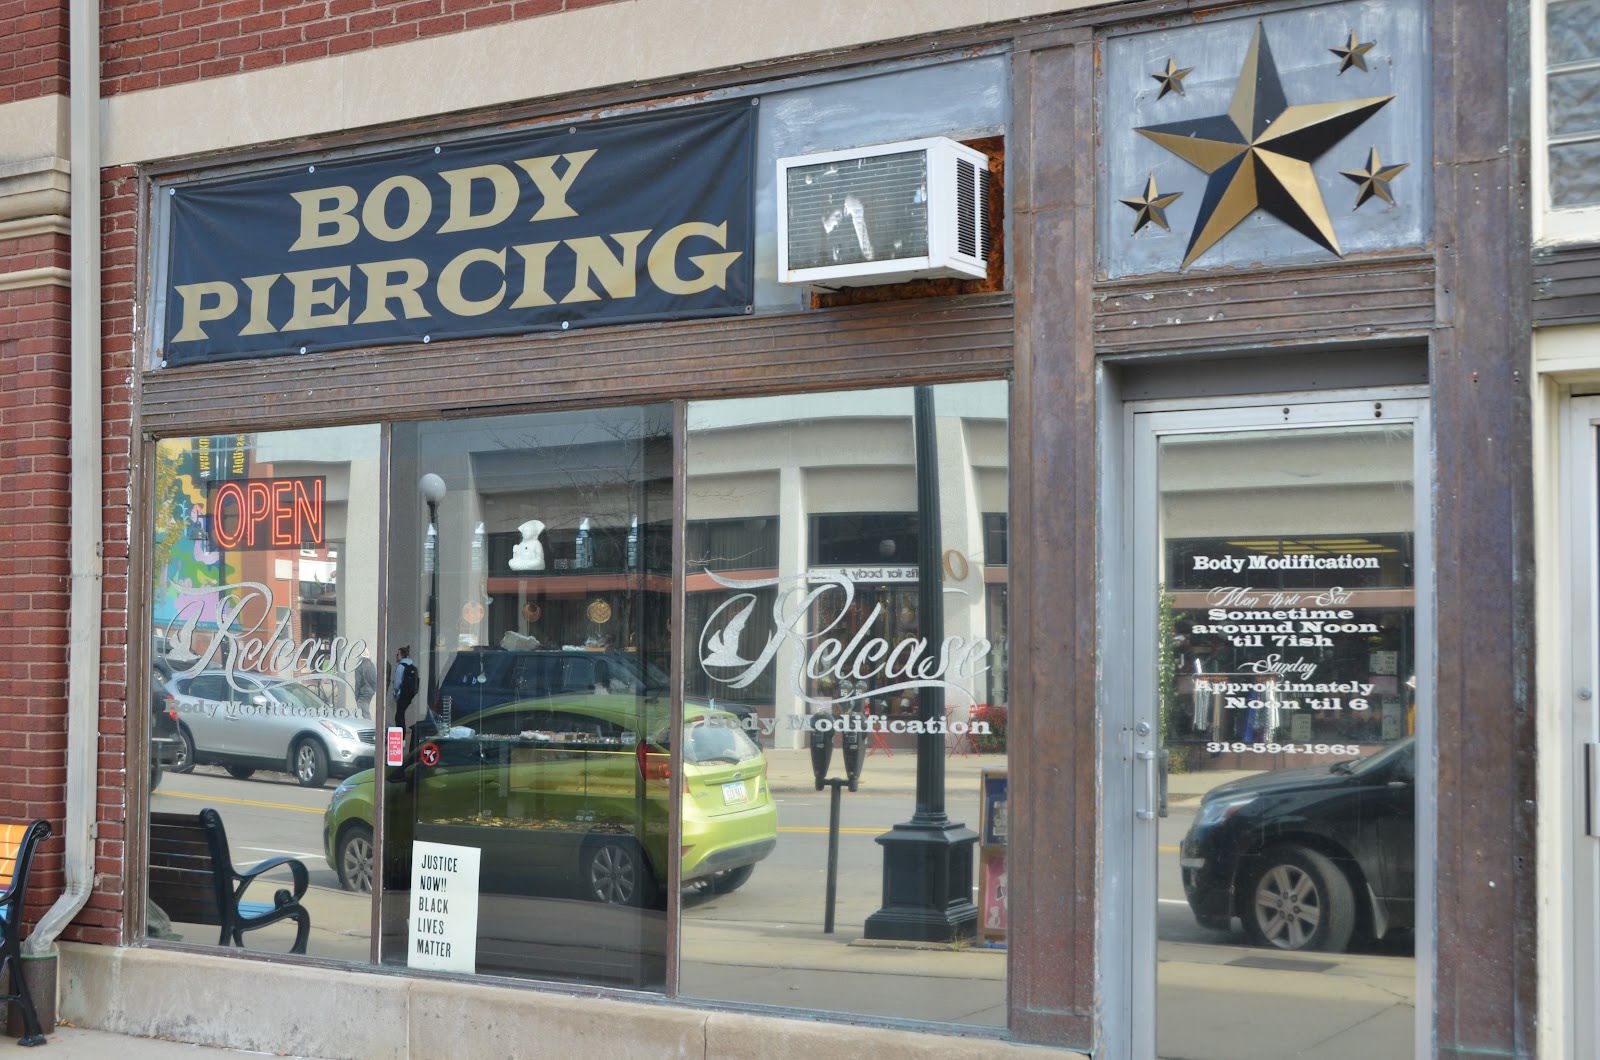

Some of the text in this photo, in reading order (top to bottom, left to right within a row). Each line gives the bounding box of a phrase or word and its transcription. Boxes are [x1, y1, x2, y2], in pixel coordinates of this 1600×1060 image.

[289, 149, 598, 253] BODY
[171, 220, 743, 343] PIERCING
[214, 479, 322, 548] OPEN
[1193, 554, 1380, 573] Body Modification
[1207, 586, 1260, 608] Mon
[1302, 586, 1354, 607] Sat
[1208, 608, 1354, 621] Sometime
[163, 581, 368, 693] Release
[1192, 621, 1380, 634] around Noon
[699, 567, 993, 709] Release
[1228, 634, 1335, 647] 'til 7ish
[1237, 654, 1318, 681] Sunday
[1196, 680, 1374, 696] Approximately
[164, 699, 363, 719] Body Modification
[1225, 697, 1369, 710] Noon 'til 6
[704, 713, 993, 735] Body Modification
[1206, 742, 1361, 755] 319-594-1965
[421, 854, 458, 873] JUSTICE
[419, 875, 447, 892] NOW!!
[418, 896, 449, 914] BLACK
[417, 917, 444, 935] LIVES
[416, 938, 451, 958] MATTER
